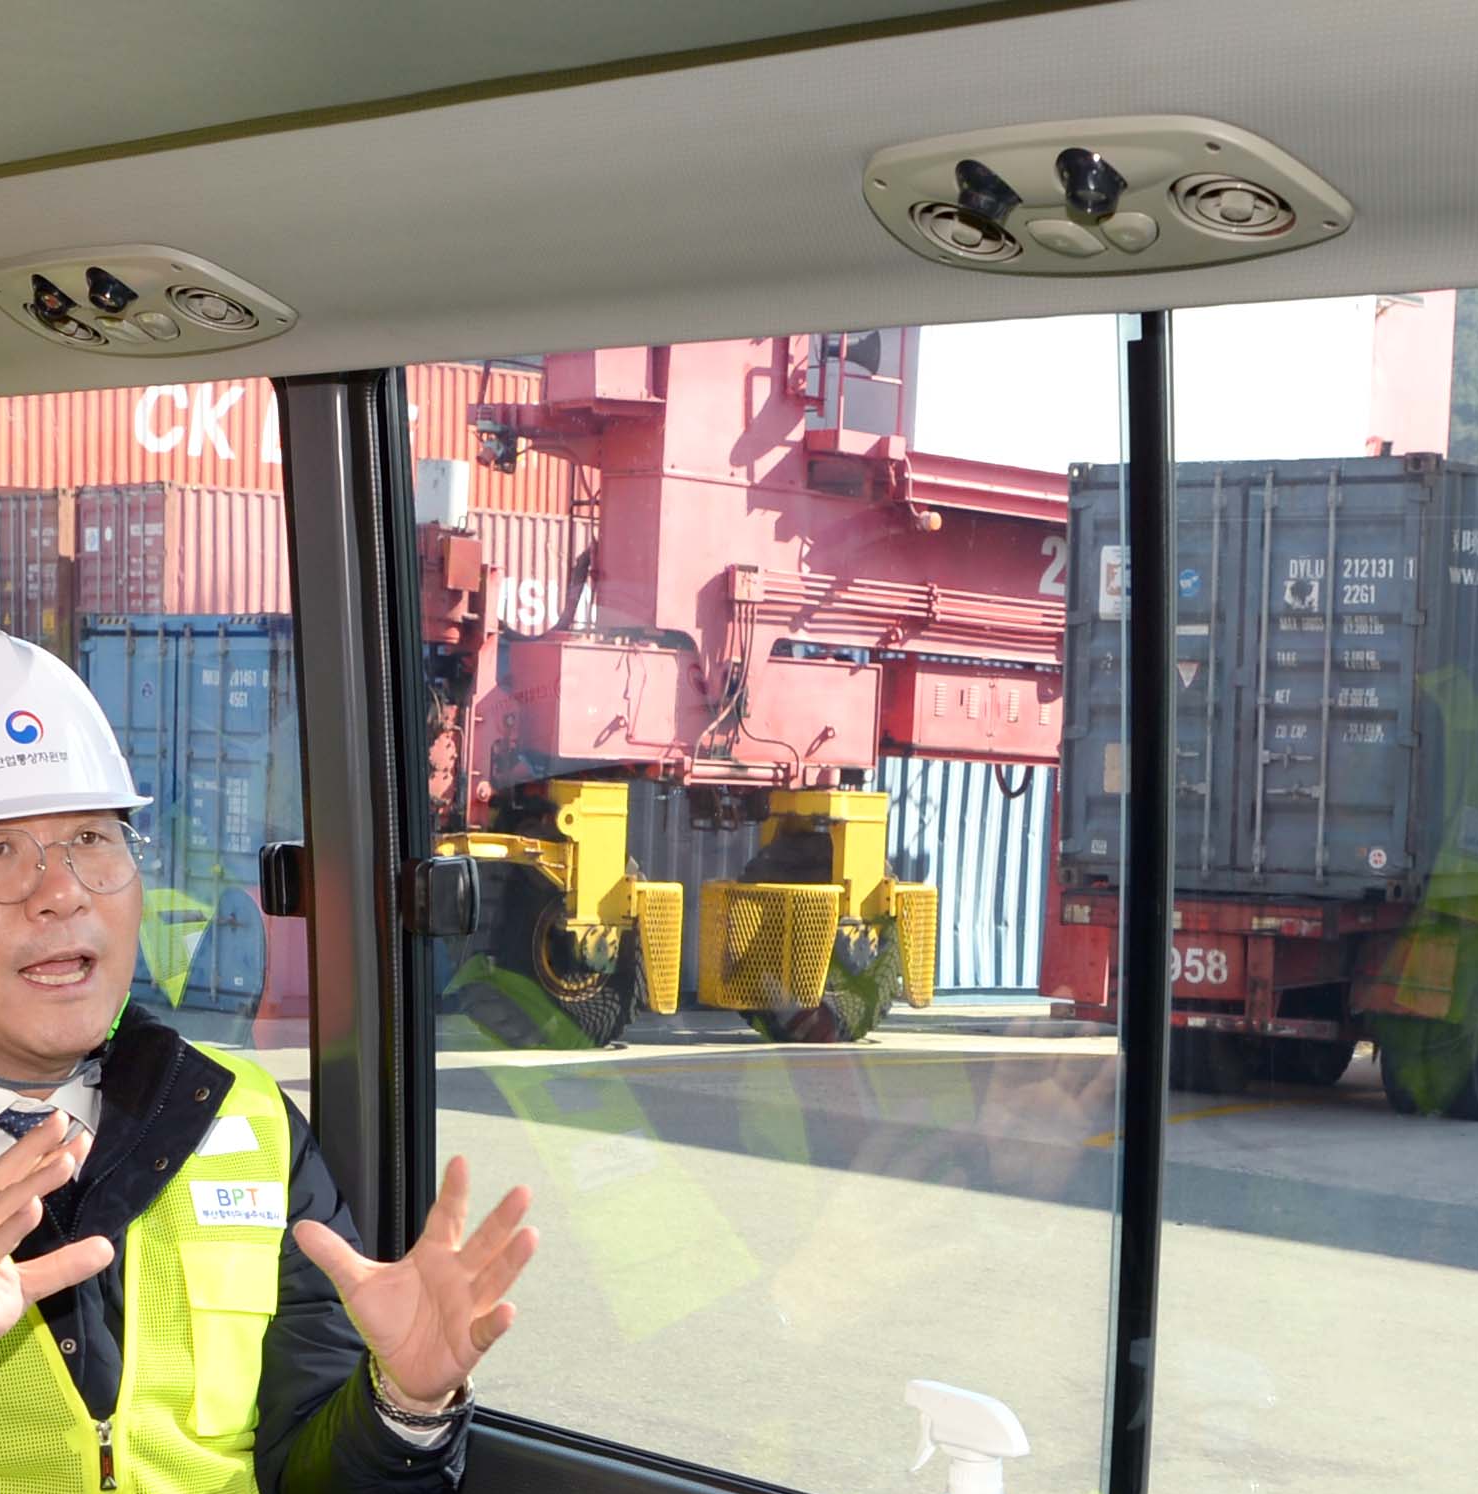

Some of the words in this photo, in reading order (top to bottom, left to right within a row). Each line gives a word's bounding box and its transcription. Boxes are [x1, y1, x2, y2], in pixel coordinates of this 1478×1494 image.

[134, 383, 244, 461] CK
[1288, 558, 1325, 579] DYLU
[1342, 557, 1395, 579] 212131
[216, 1187, 259, 1207] BPT
